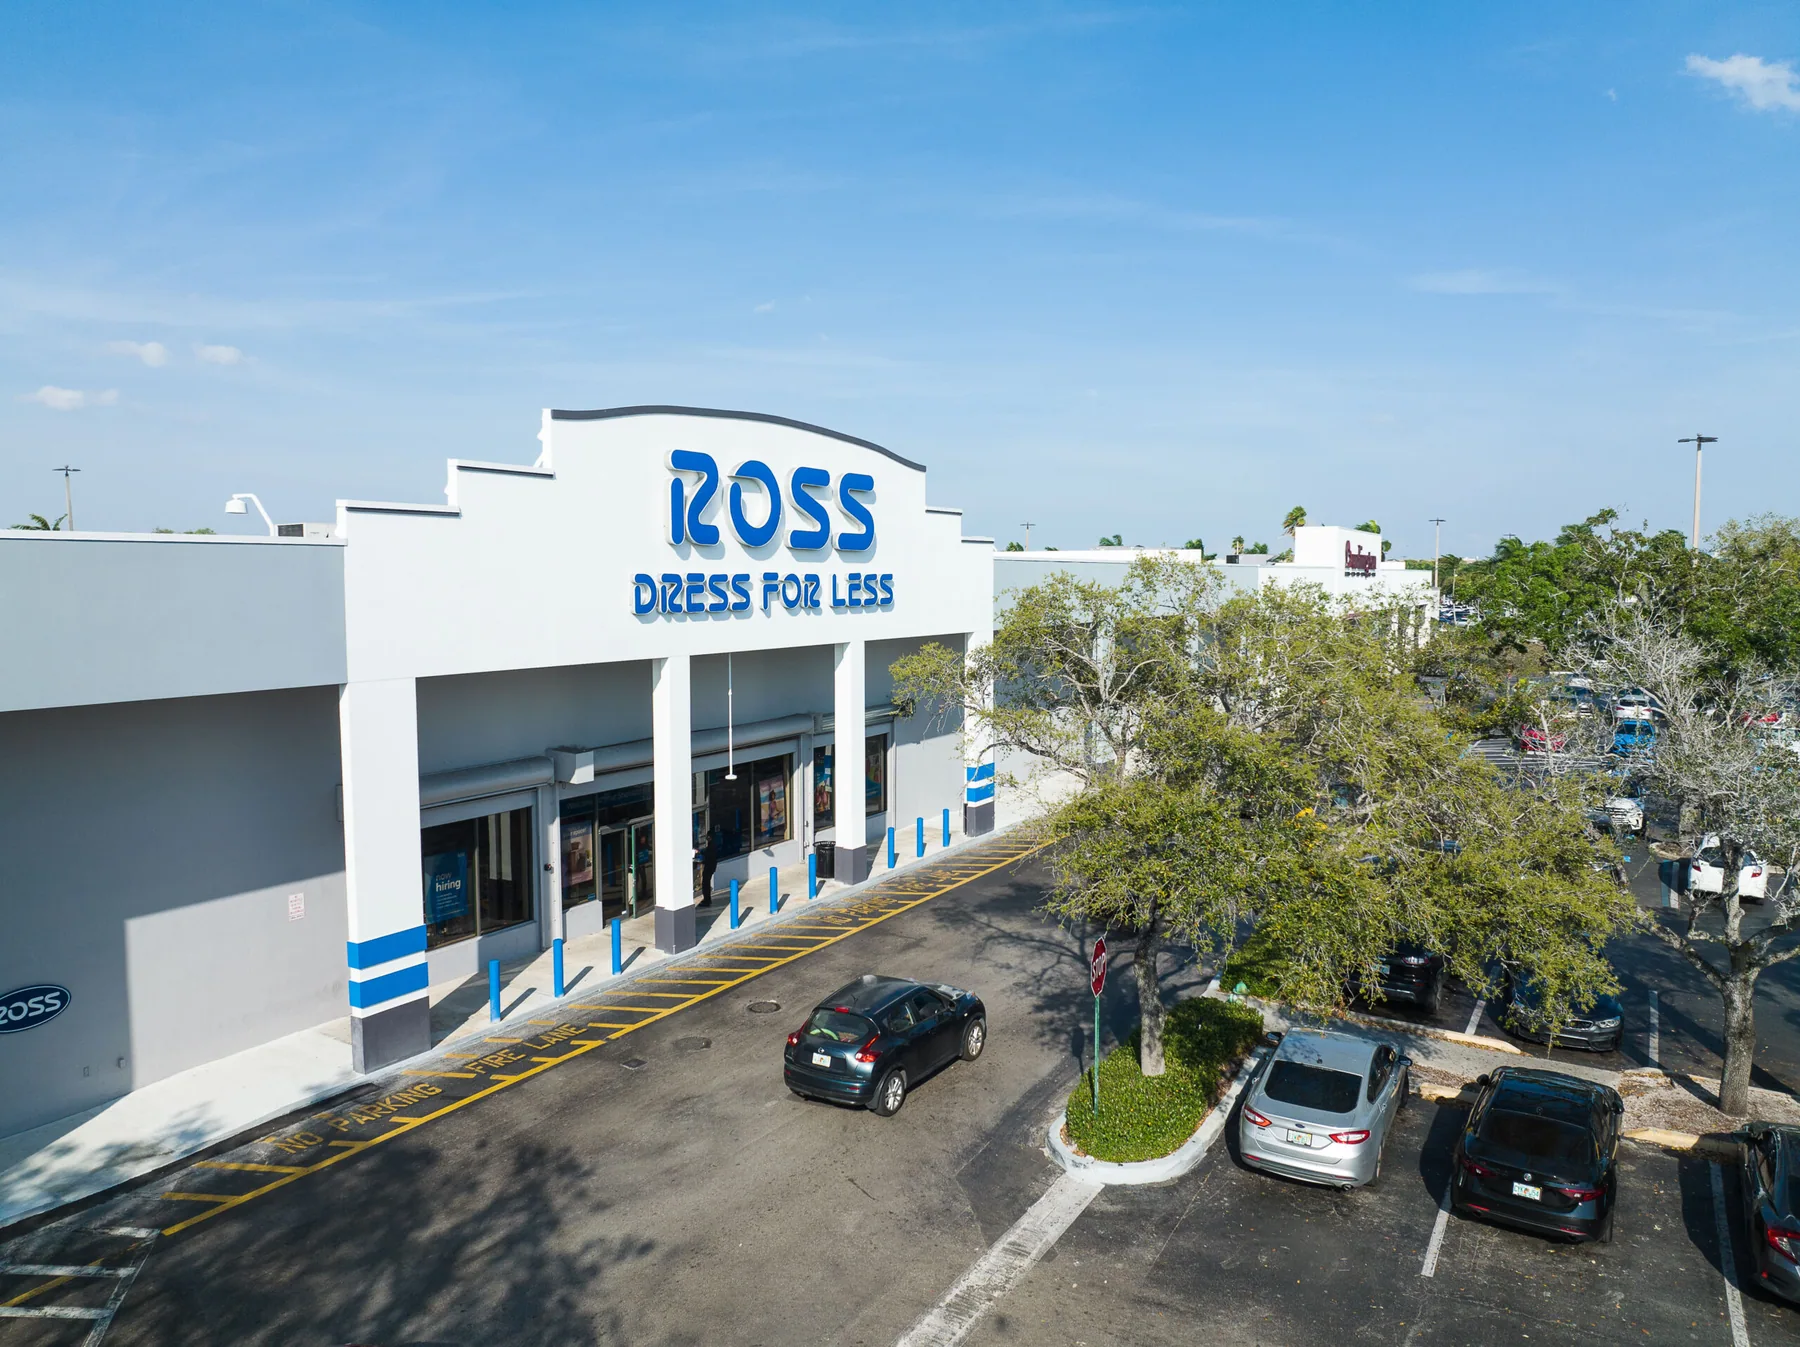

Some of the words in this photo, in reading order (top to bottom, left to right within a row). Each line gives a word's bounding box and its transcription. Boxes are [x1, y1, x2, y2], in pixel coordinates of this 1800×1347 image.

[667, 449, 875, 551] ROSS
[633, 573, 751, 615] DRESS
[761, 572, 821, 610] FOR
[831, 572, 893, 608] LESS
[435, 880, 462, 892] hiring
[273, 1130, 324, 1154] NO
[328, 1083, 443, 1132] PARKING
[464, 1049, 527, 1074] FIRE
[523, 1023, 588, 1050] LANE
